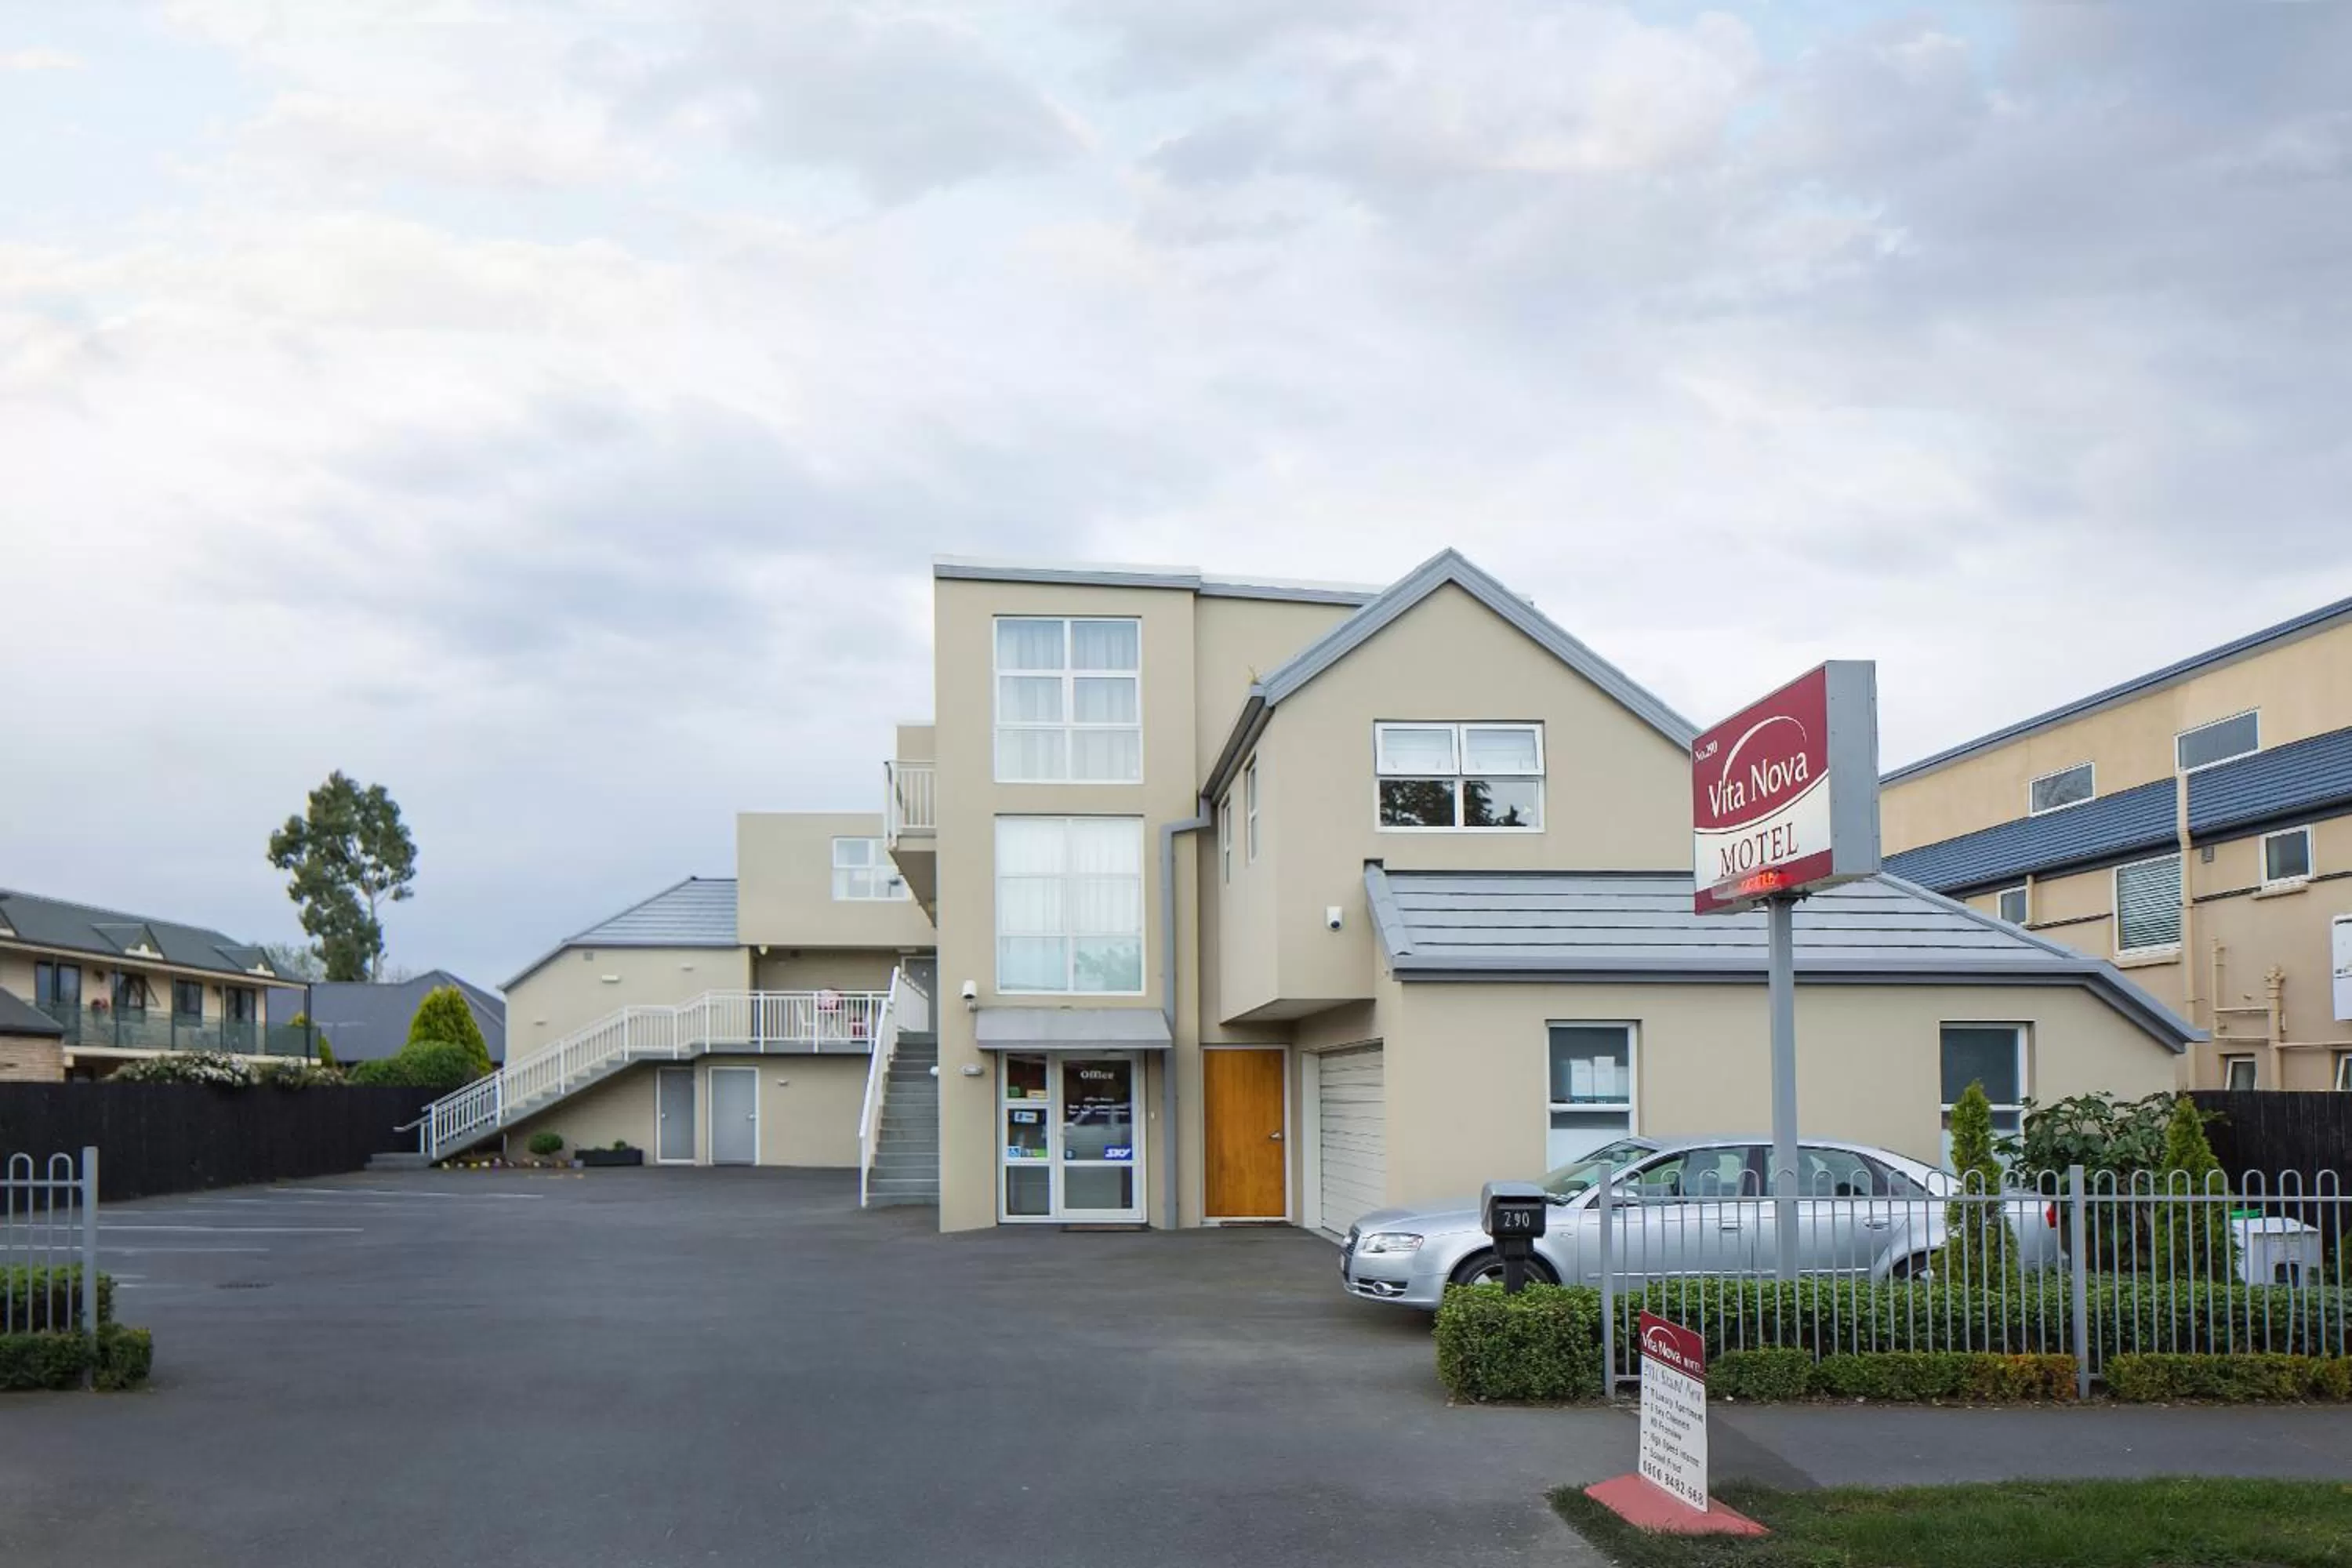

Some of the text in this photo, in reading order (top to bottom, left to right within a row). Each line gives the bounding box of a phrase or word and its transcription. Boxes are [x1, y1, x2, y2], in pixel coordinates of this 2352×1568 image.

[1708, 750, 1809, 819] Vita Nova
[1719, 822, 1799, 879] MOTEL
[1080, 1069, 1115, 1080] Office
[1504, 1210, 1530, 1228] 290
[1640, 1331, 1658, 1353] Vita
[1658, 1340, 1682, 1365] Nova
